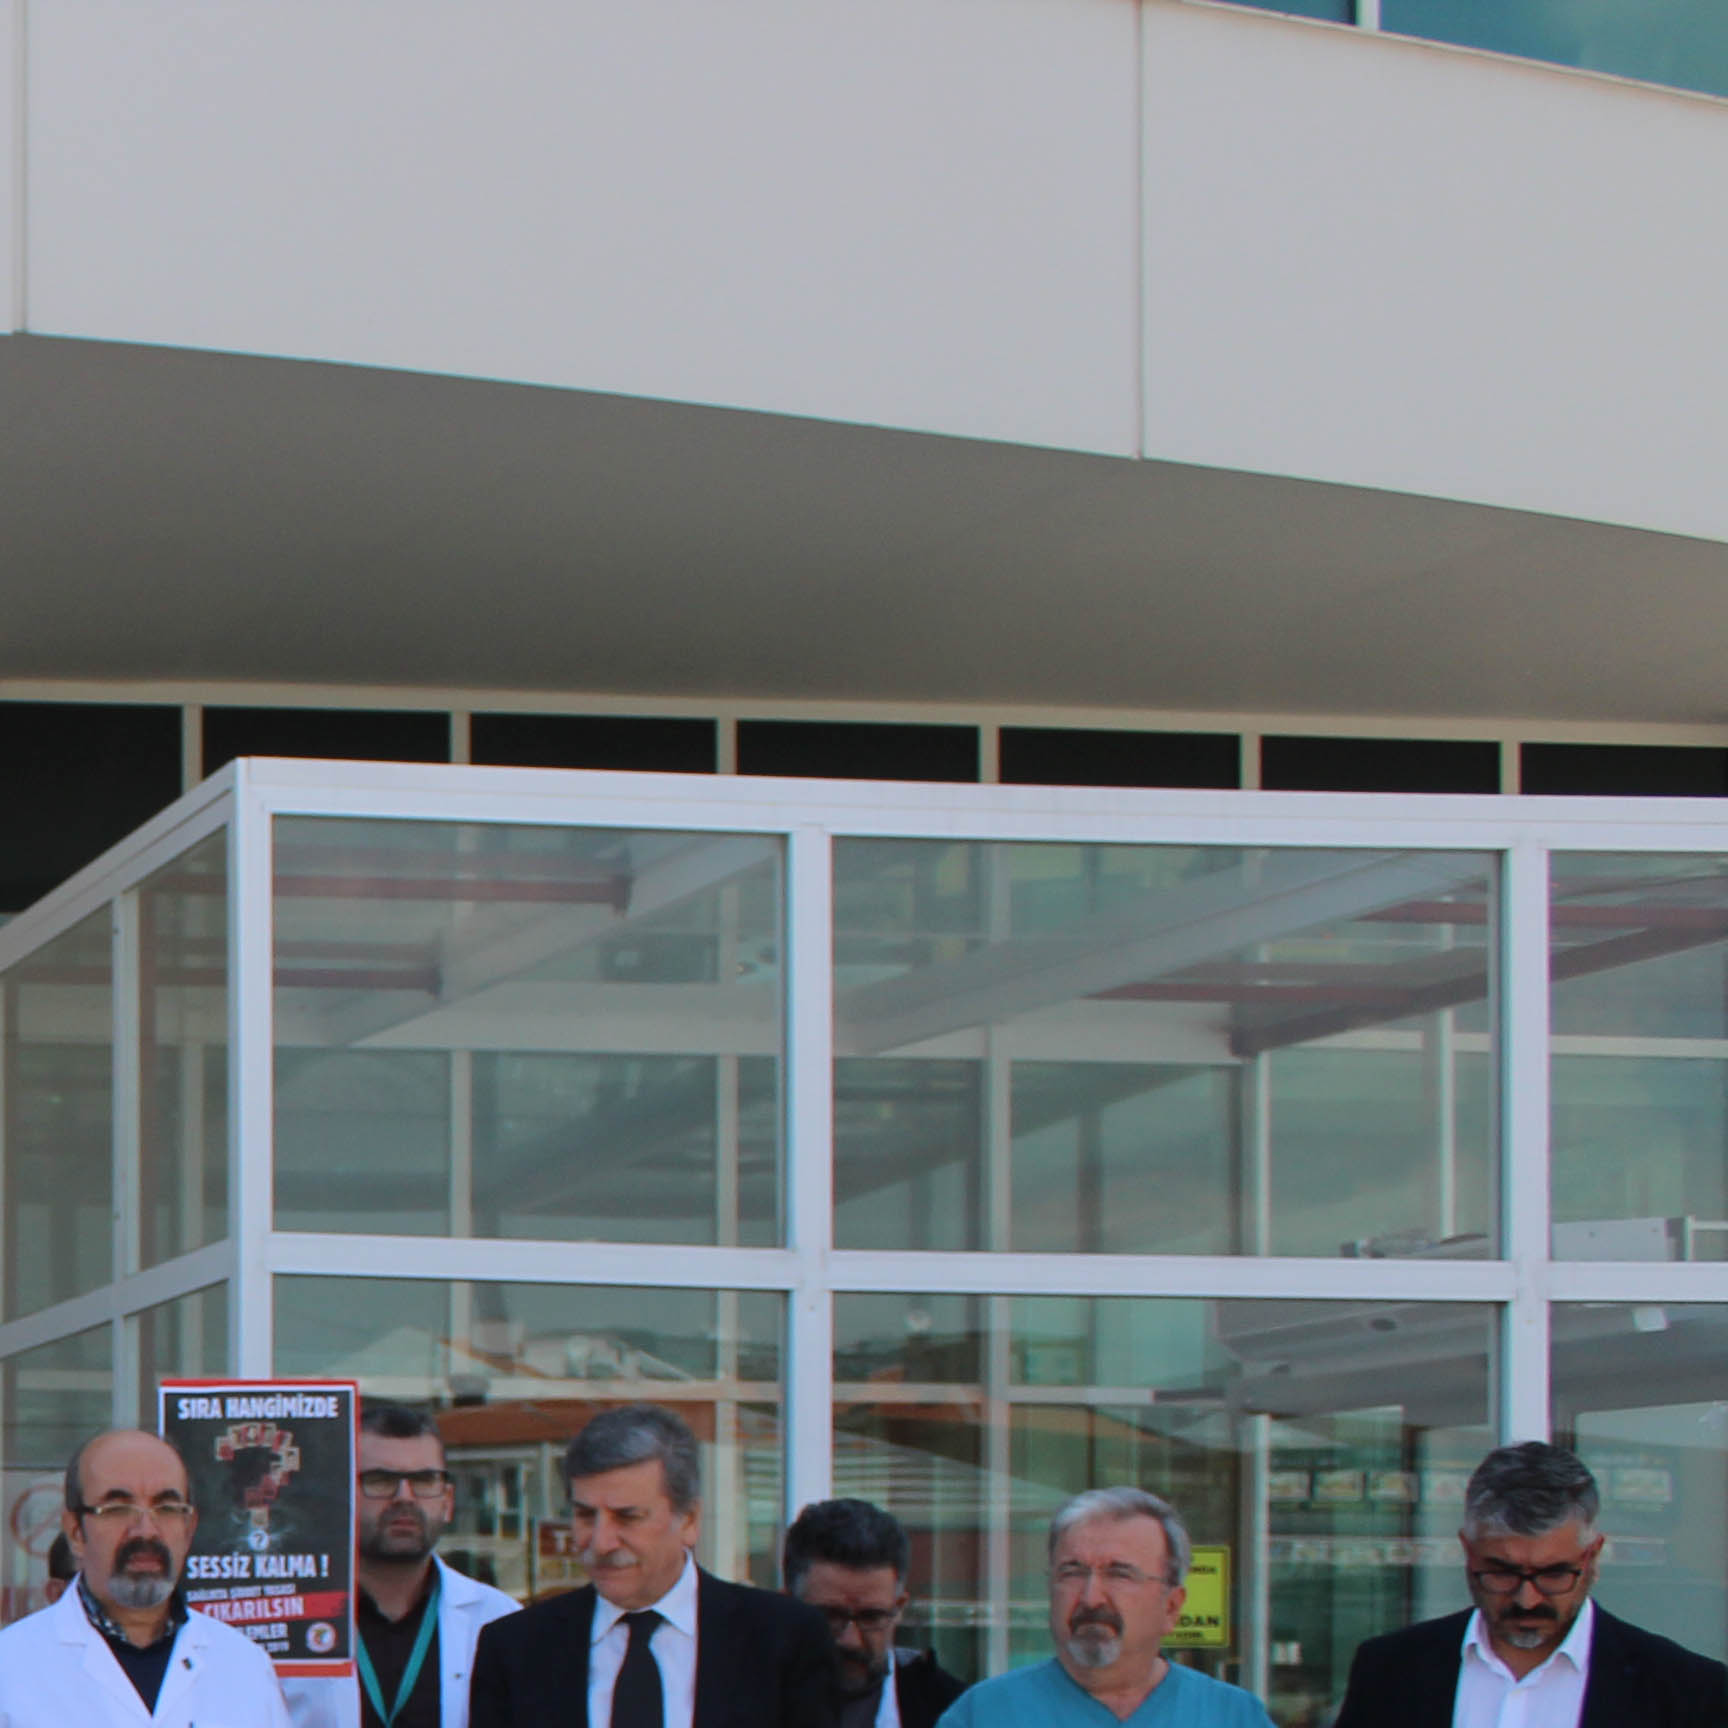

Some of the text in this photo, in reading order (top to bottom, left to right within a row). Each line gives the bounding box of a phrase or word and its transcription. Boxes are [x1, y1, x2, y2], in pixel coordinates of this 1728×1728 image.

[178, 1393, 339, 1419] SIRA HANGİMİZDE
[186, 1552, 251, 1580] SESSİZ
[255, 1554, 317, 1579] KALMA
